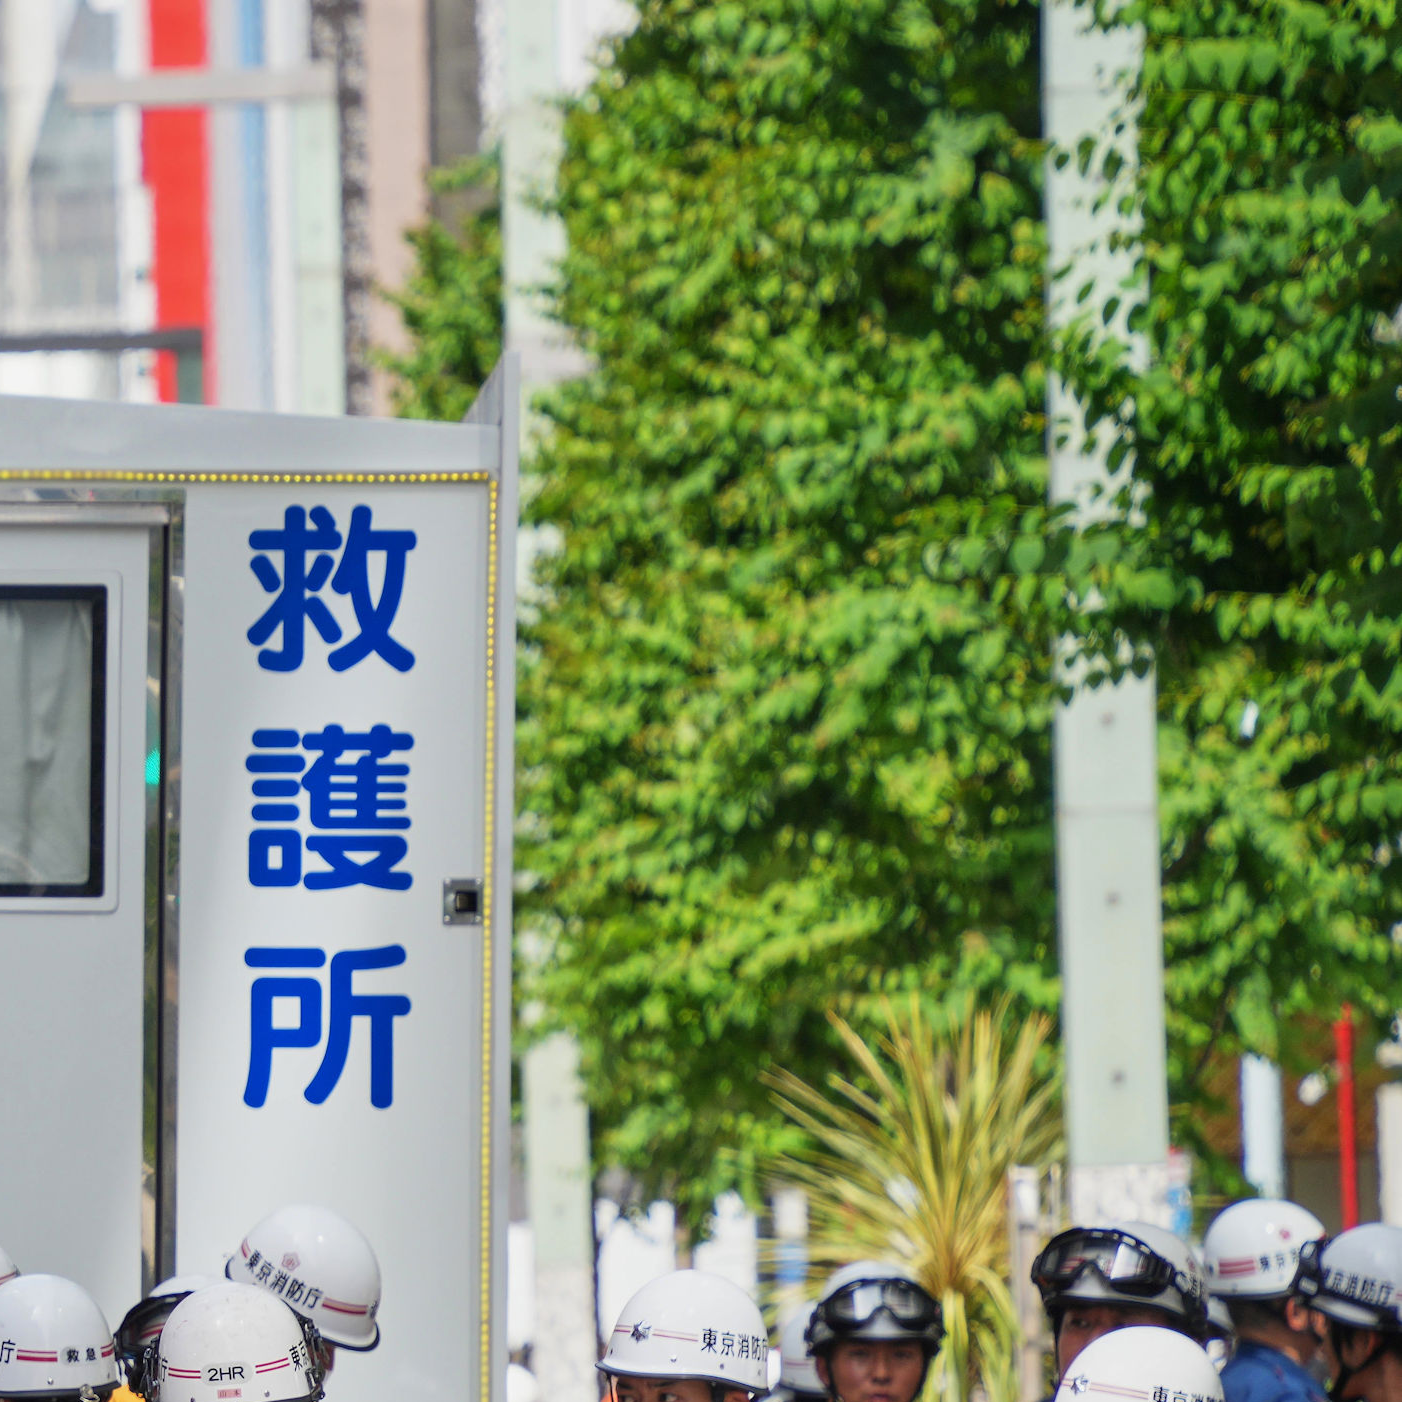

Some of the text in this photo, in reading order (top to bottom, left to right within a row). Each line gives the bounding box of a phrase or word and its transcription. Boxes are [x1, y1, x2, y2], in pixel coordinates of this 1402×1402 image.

[243, 504, 418, 1110] 救護所
[246, 1249, 324, 1310] 東京消防庁
[66, 1347, 97, 1363] 救急
[207, 1365, 245, 1382] 2HR
